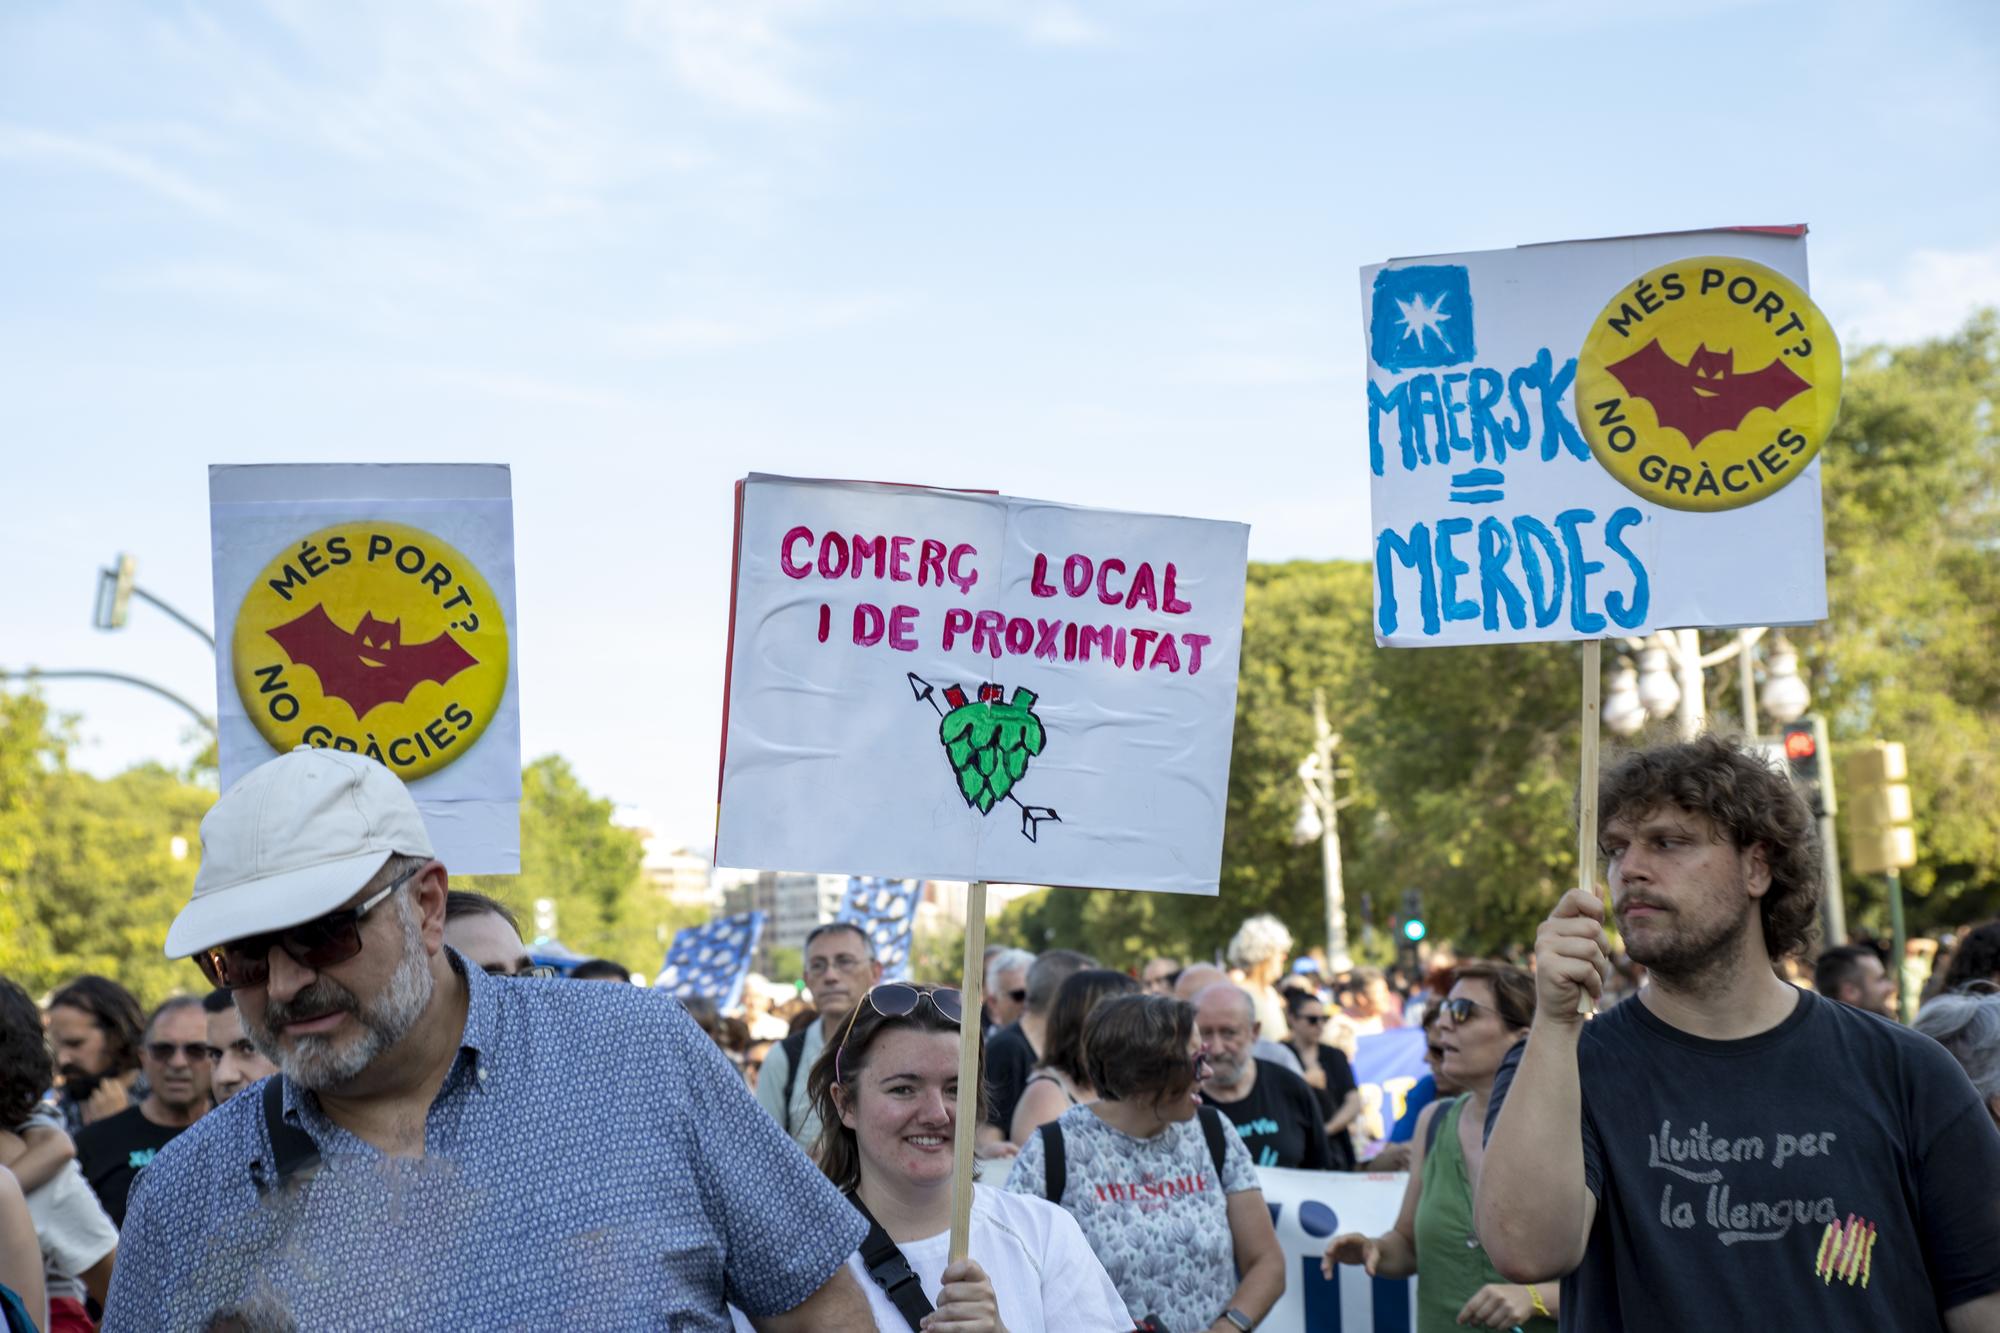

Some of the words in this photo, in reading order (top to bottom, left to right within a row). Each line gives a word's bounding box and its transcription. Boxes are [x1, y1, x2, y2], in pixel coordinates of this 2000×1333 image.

[1608, 273, 1685, 337] MÉS
[1701, 268, 1812, 357] PORT?
[1367, 347, 1591, 477] MAERSK
[1594, 399, 1636, 452] NO
[1638, 428, 1806, 496] GRÀCIES
[269, 536, 351, 601] MÉS
[368, 534, 479, 632] PORT?
[781, 526, 978, 594] COMERÇ
[1031, 553, 1192, 614] LOCAL
[1376, 507, 1650, 635] MERDES
[818, 604, 830, 643] I
[852, 603, 920, 651] DE
[942, 608, 1212, 675] PROXIMITAT
[254, 664, 299, 722] NO
[1772, 1131, 1837, 1169] per
[1660, 1184, 1696, 1228] la
[1706, 1184, 1837, 1247] llengua
